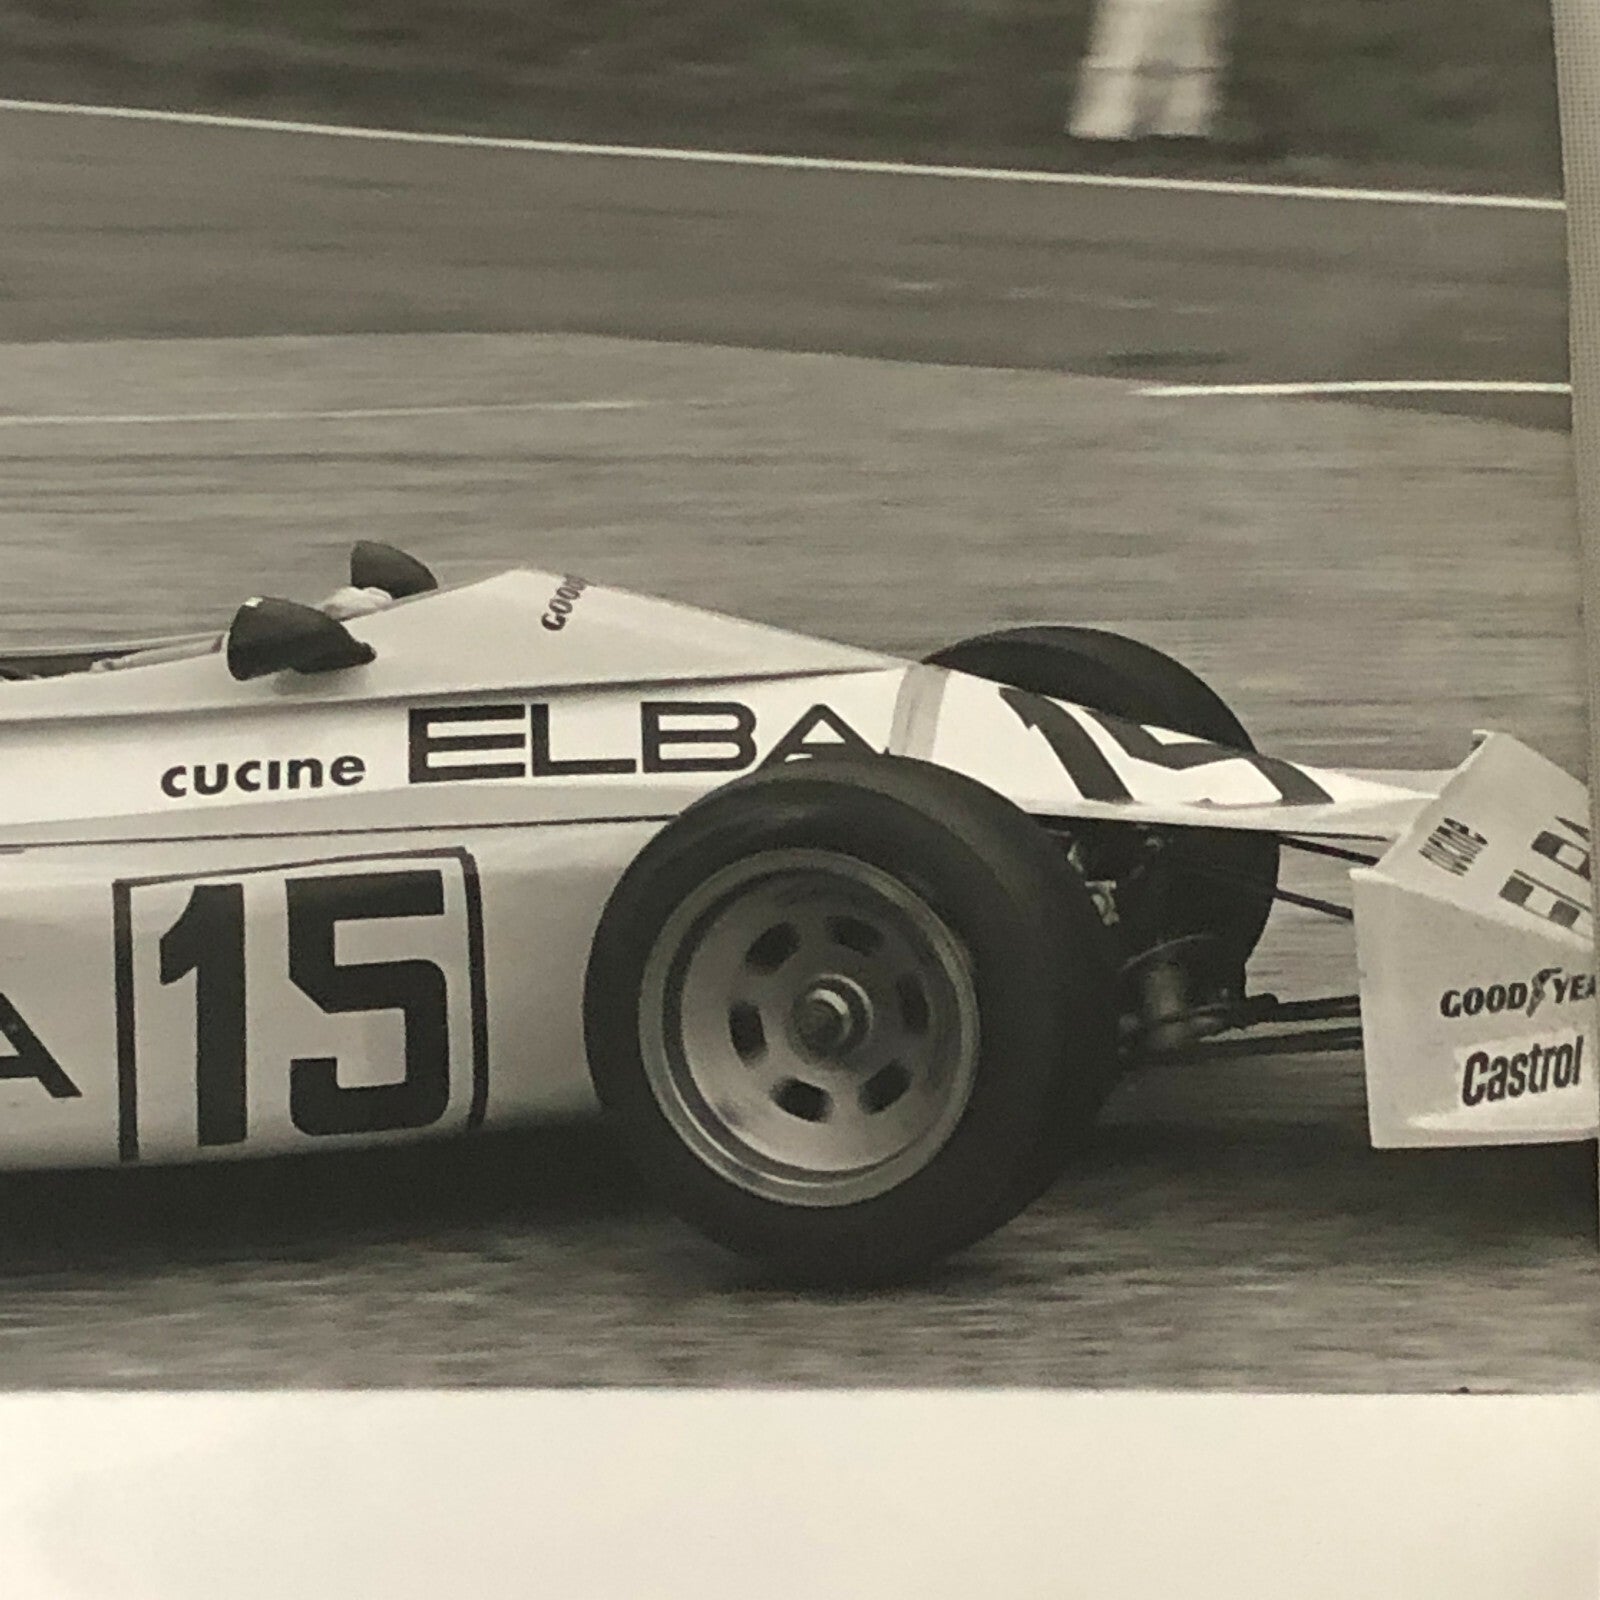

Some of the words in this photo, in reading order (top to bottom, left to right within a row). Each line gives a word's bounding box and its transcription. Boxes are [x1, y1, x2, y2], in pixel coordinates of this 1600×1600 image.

[161, 755, 365, 798] cucine
[409, 701, 885, 783] ELBA
[160, 869, 450, 1147] 15
[1462, 1034, 1584, 1106] Castrol
